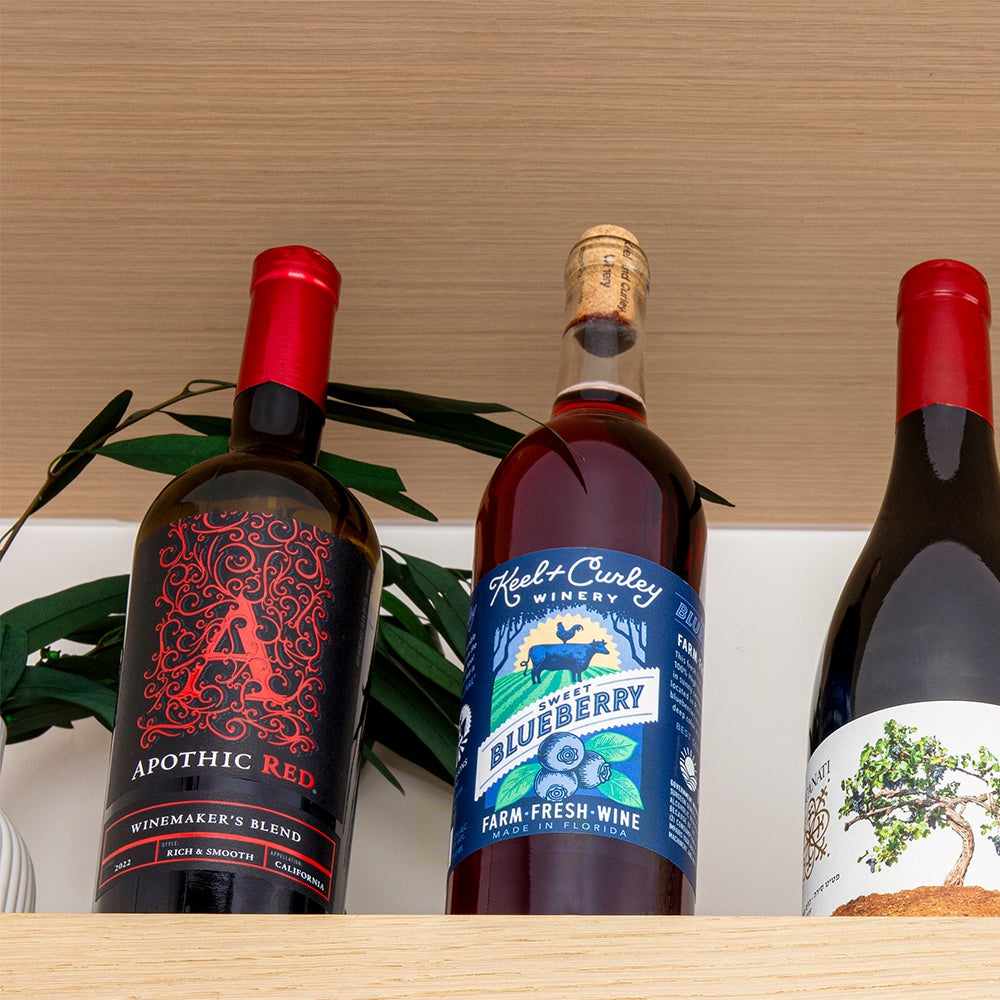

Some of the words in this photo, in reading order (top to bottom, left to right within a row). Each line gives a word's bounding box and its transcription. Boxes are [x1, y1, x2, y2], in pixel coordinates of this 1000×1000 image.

[533, 590, 620, 605] WINERY
[567, 555, 663, 608] Curley
[537, 683, 592, 712] SWEET
[489, 684, 645, 771] BLUEBERRY
[131, 749, 253, 782] APOTHIC
[260, 753, 316, 792] RED
[130, 812, 245, 835] WINEMAKER'S
[249, 816, 303, 844] BLEND
[492, 823, 530, 840] MADE
[537, 821, 555, 830] IN
[563, 821, 628, 838] FLORIDA
[113, 858, 132, 872] 2022
[166, 847, 193, 858] RICH
[195, 848, 204, 856] &
[205, 848, 255, 861] SMOOTH
[274, 859, 326, 892] CALIFORNIA
